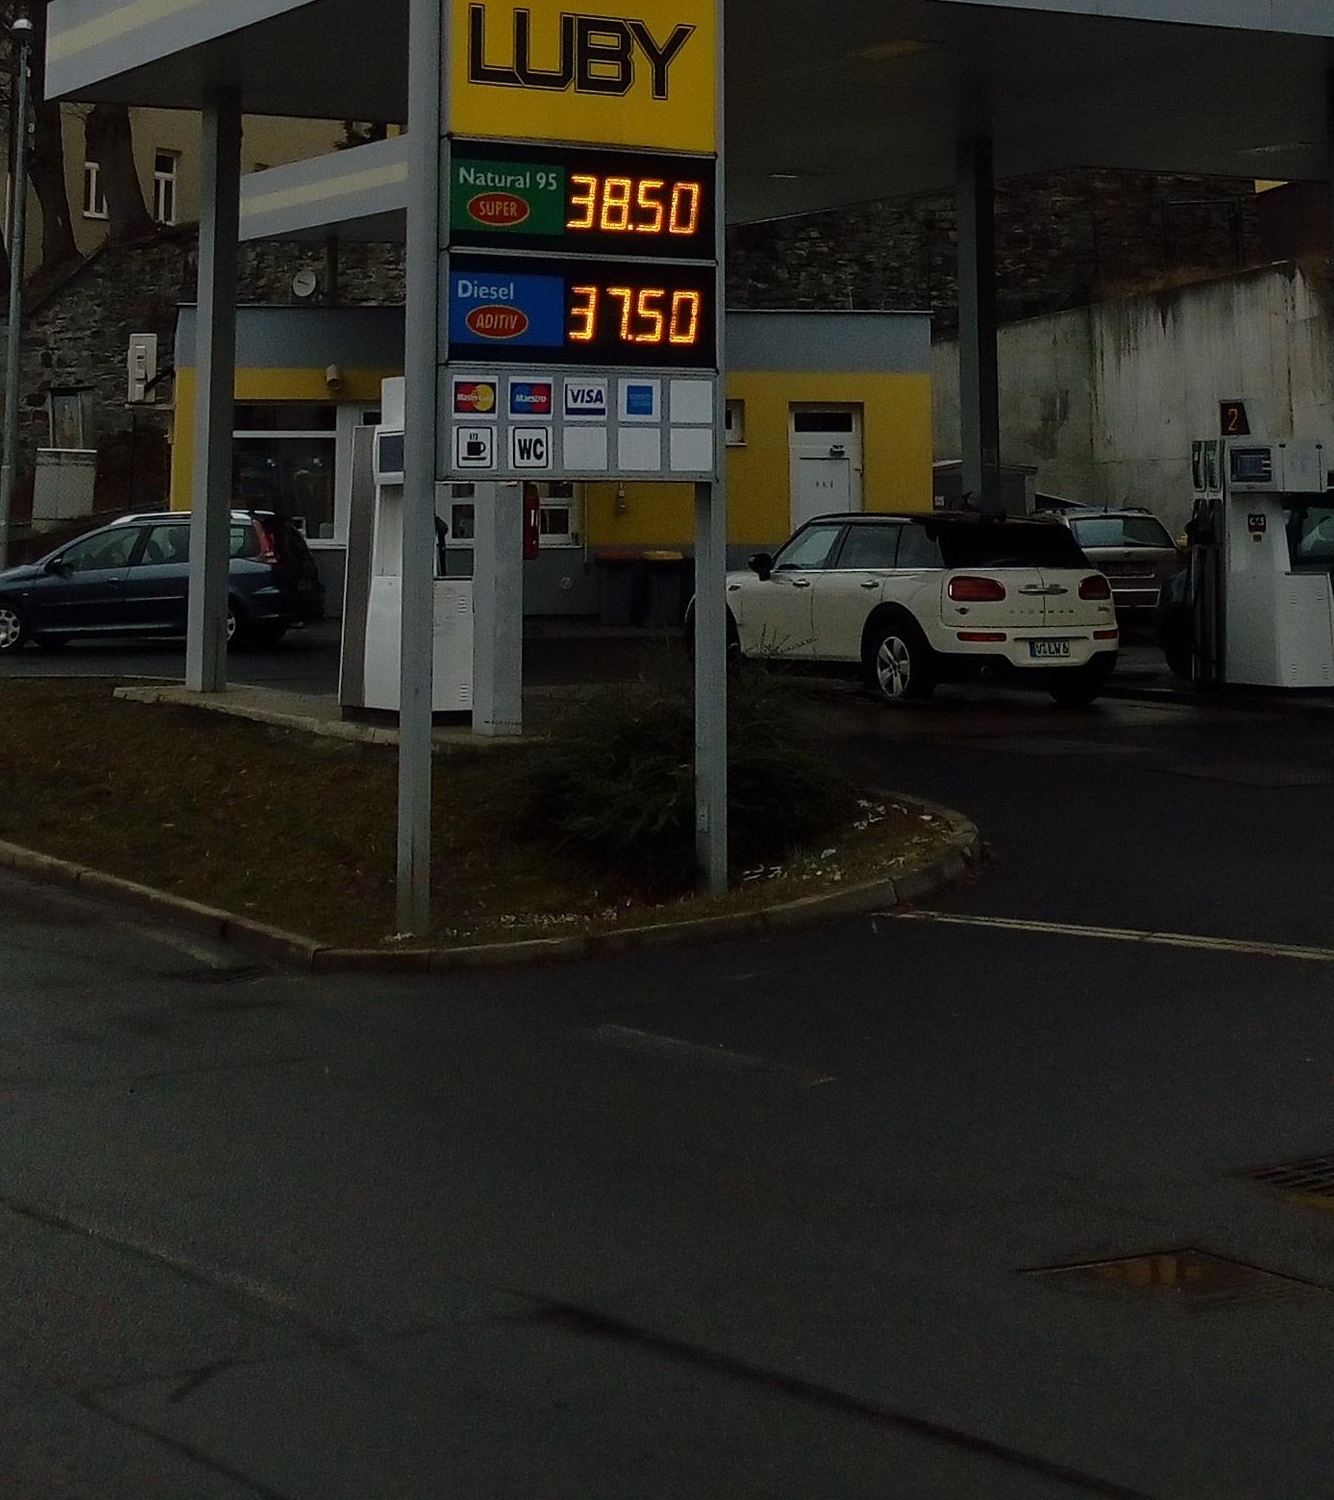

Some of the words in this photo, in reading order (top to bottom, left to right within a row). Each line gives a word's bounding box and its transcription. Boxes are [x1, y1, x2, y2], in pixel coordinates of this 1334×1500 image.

[468, 3, 696, 100] LUBY
[459, 166, 530, 189] Natural
[537, 172, 558, 190] 95
[479, 200, 517, 217] SUPER
[567, 174, 699, 234] 38.50
[457, 280, 515, 300] Diesel
[475, 313, 518, 330] ADITIV
[568, 286, 700, 344] 37.50
[570, 388, 604, 404] VISA
[1226, 407, 1238, 431] 2
[517, 438, 545, 460] WC
